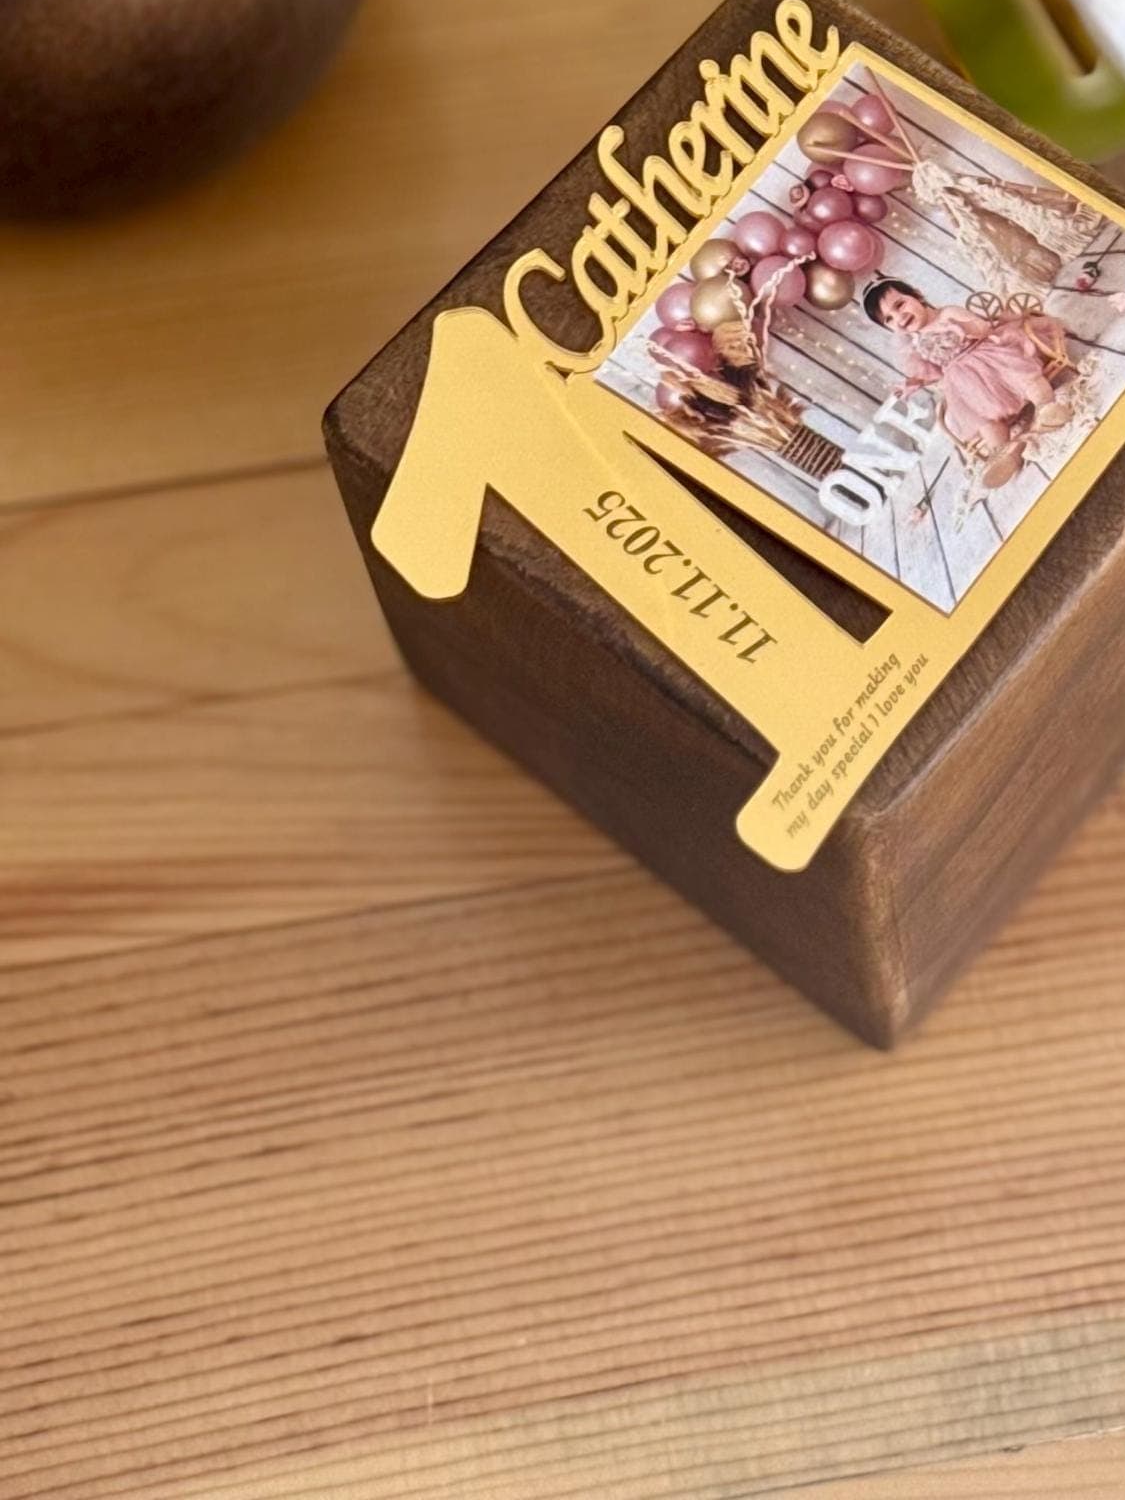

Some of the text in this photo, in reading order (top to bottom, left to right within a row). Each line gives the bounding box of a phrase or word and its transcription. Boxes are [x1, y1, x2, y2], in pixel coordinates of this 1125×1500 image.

[819, 395, 935, 526] ONE
[582, 490, 778, 664] 11.11.2025
[771, 653, 901, 811] Thank you for making
[786, 812, 810, 838] my
[807, 780, 834, 812] day
[831, 722, 874, 780] special
[875, 684, 905, 717] love
[903, 653, 929, 686] you
